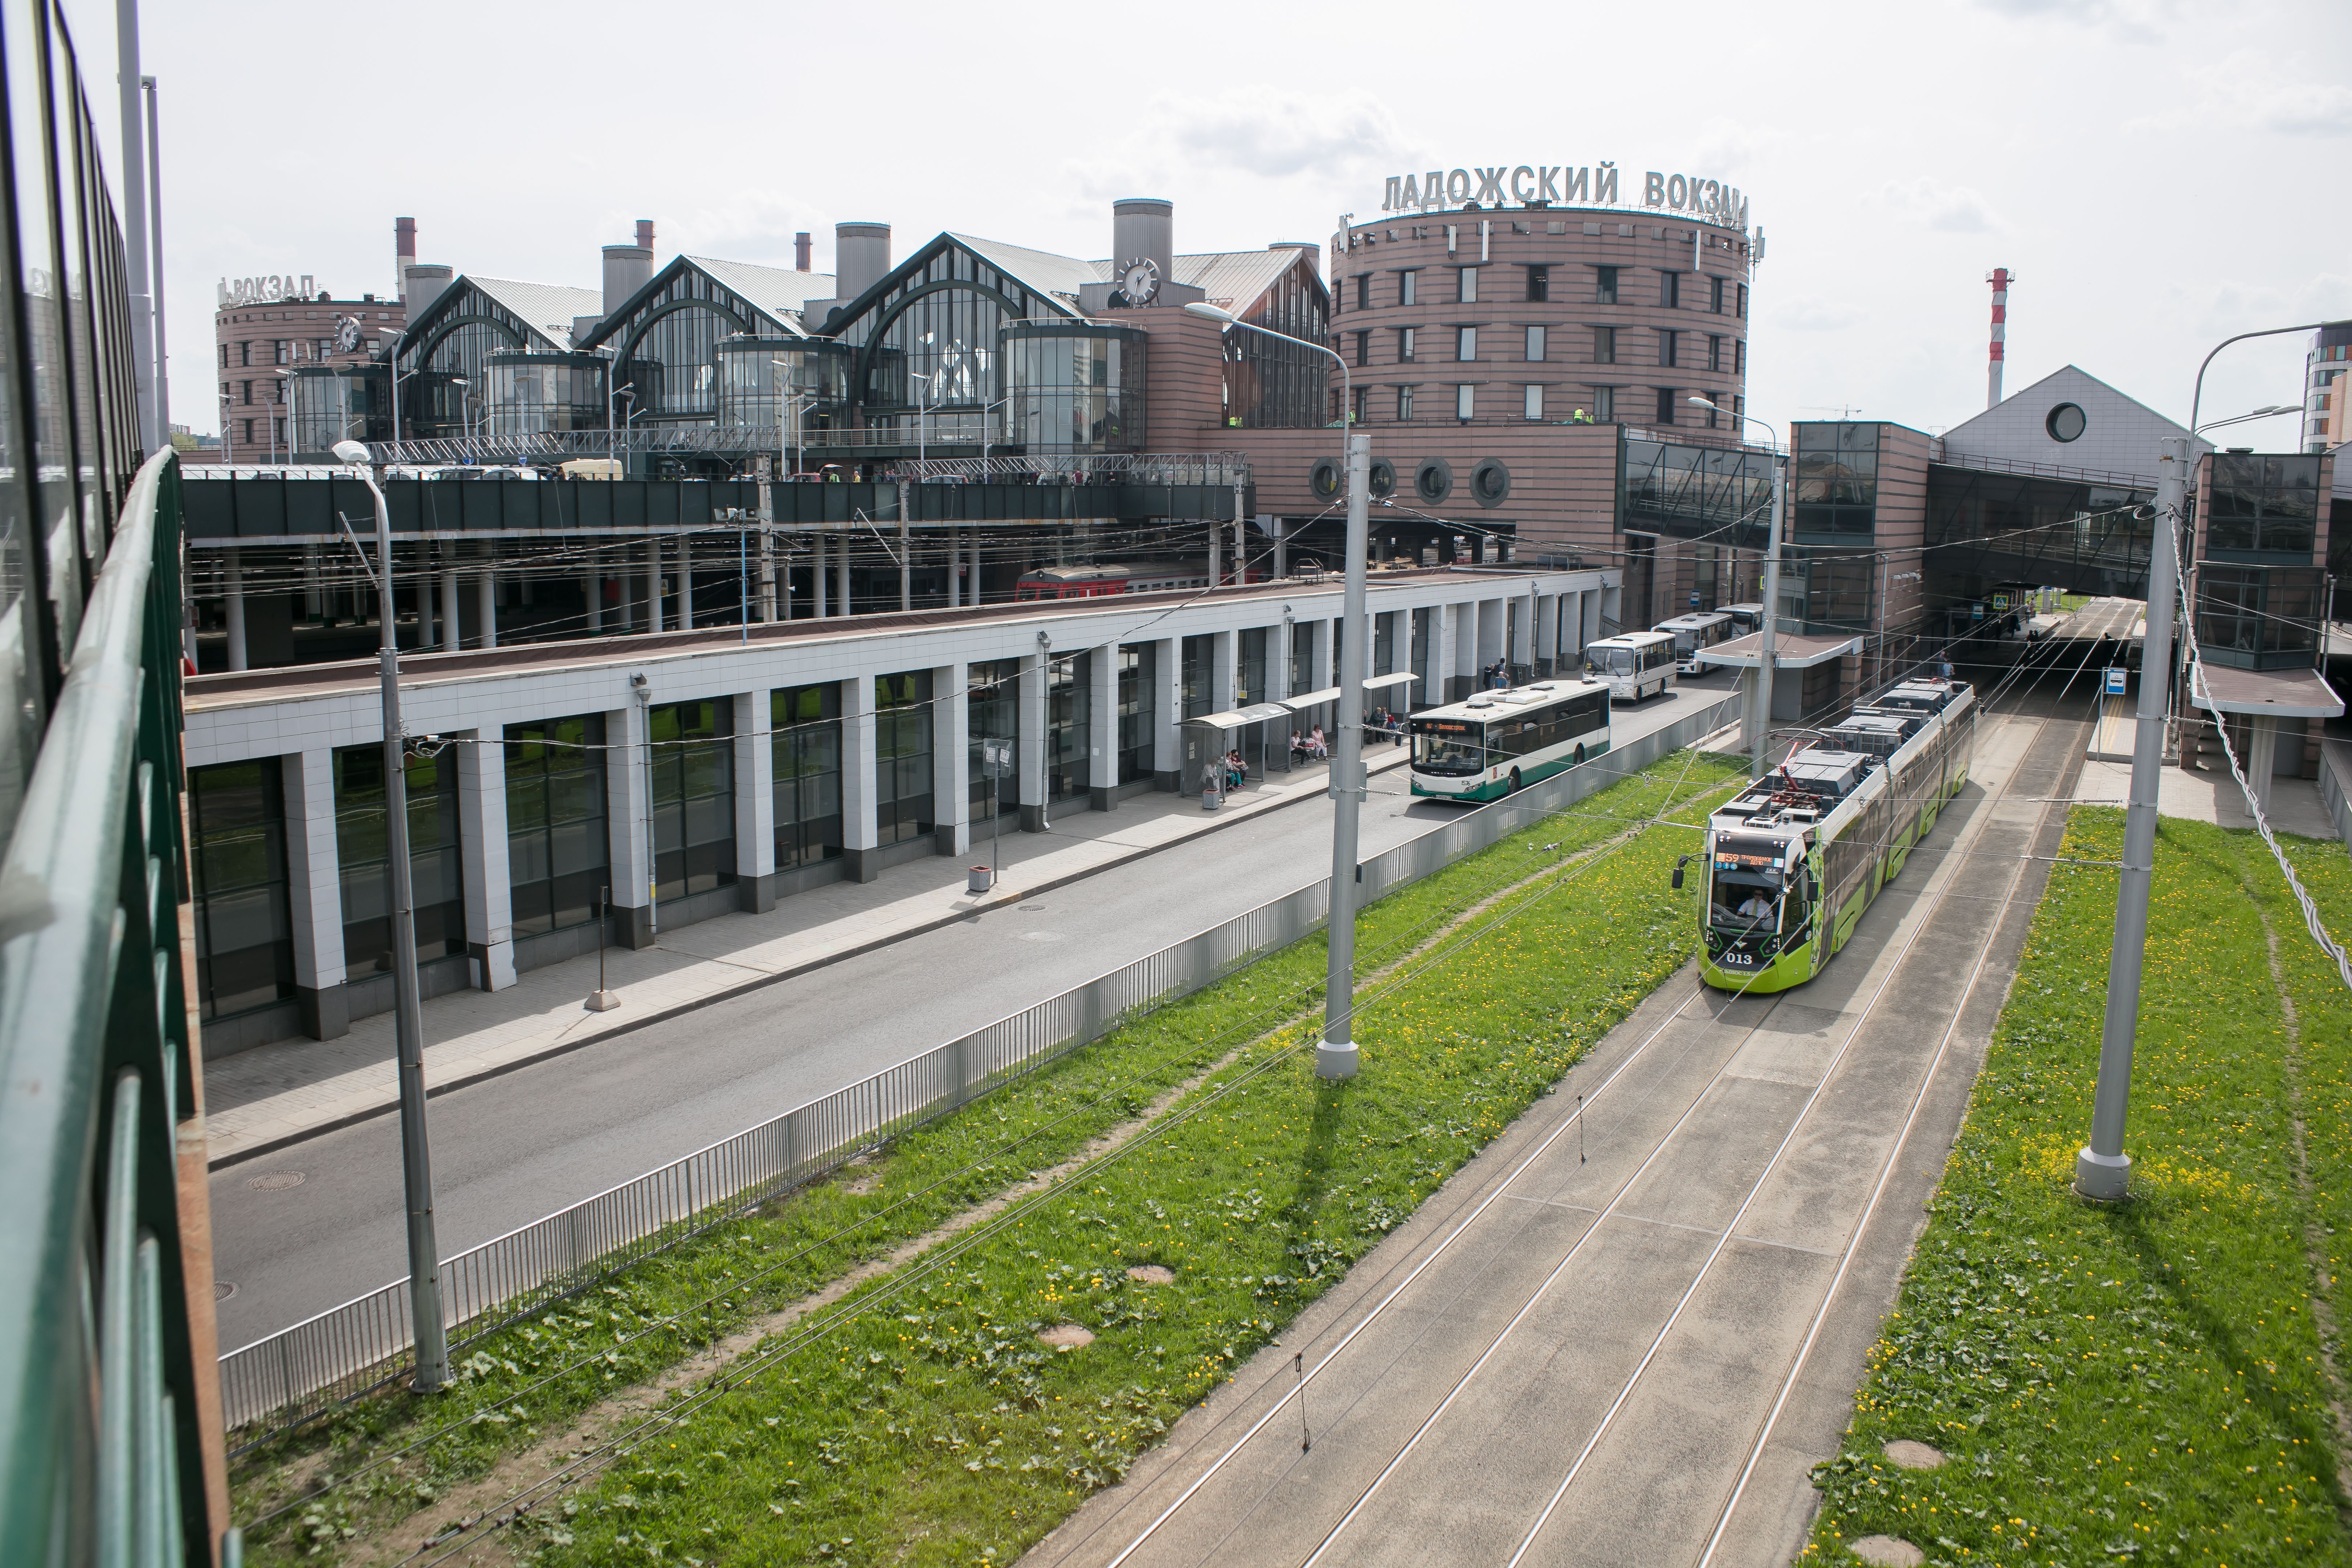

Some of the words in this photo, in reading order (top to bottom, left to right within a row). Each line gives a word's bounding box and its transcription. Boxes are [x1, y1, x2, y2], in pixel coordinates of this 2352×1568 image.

[1382, 161, 1617, 213] ЛАДОЖСКИЙ
[1646, 172, 1740, 223] ВОКЗАЛ
[234, 275, 314, 301] ВОКЗАЛ
[1726, 853, 1739, 862] 59
[1727, 953, 1752, 964] 013
